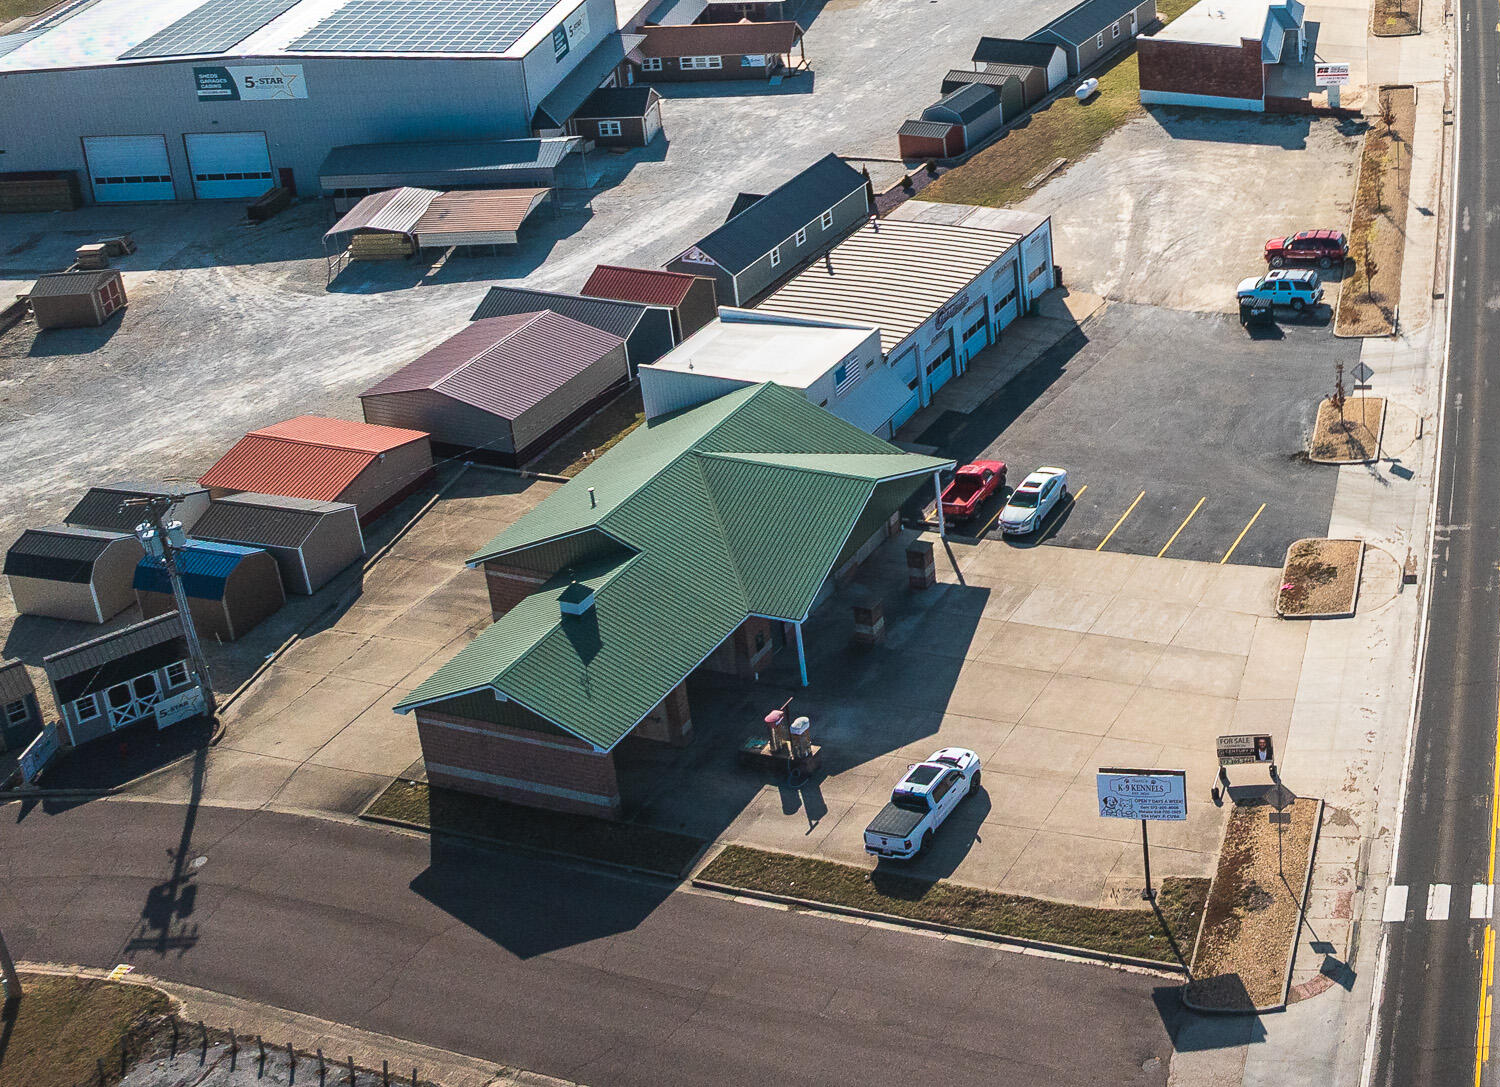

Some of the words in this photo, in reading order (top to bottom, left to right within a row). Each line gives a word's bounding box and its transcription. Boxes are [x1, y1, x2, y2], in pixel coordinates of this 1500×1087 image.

[244, 76, 284, 89] 5-STAR
[1118, 784, 1130, 792] K-9
[1131, 784, 1164, 792] KENNELS
